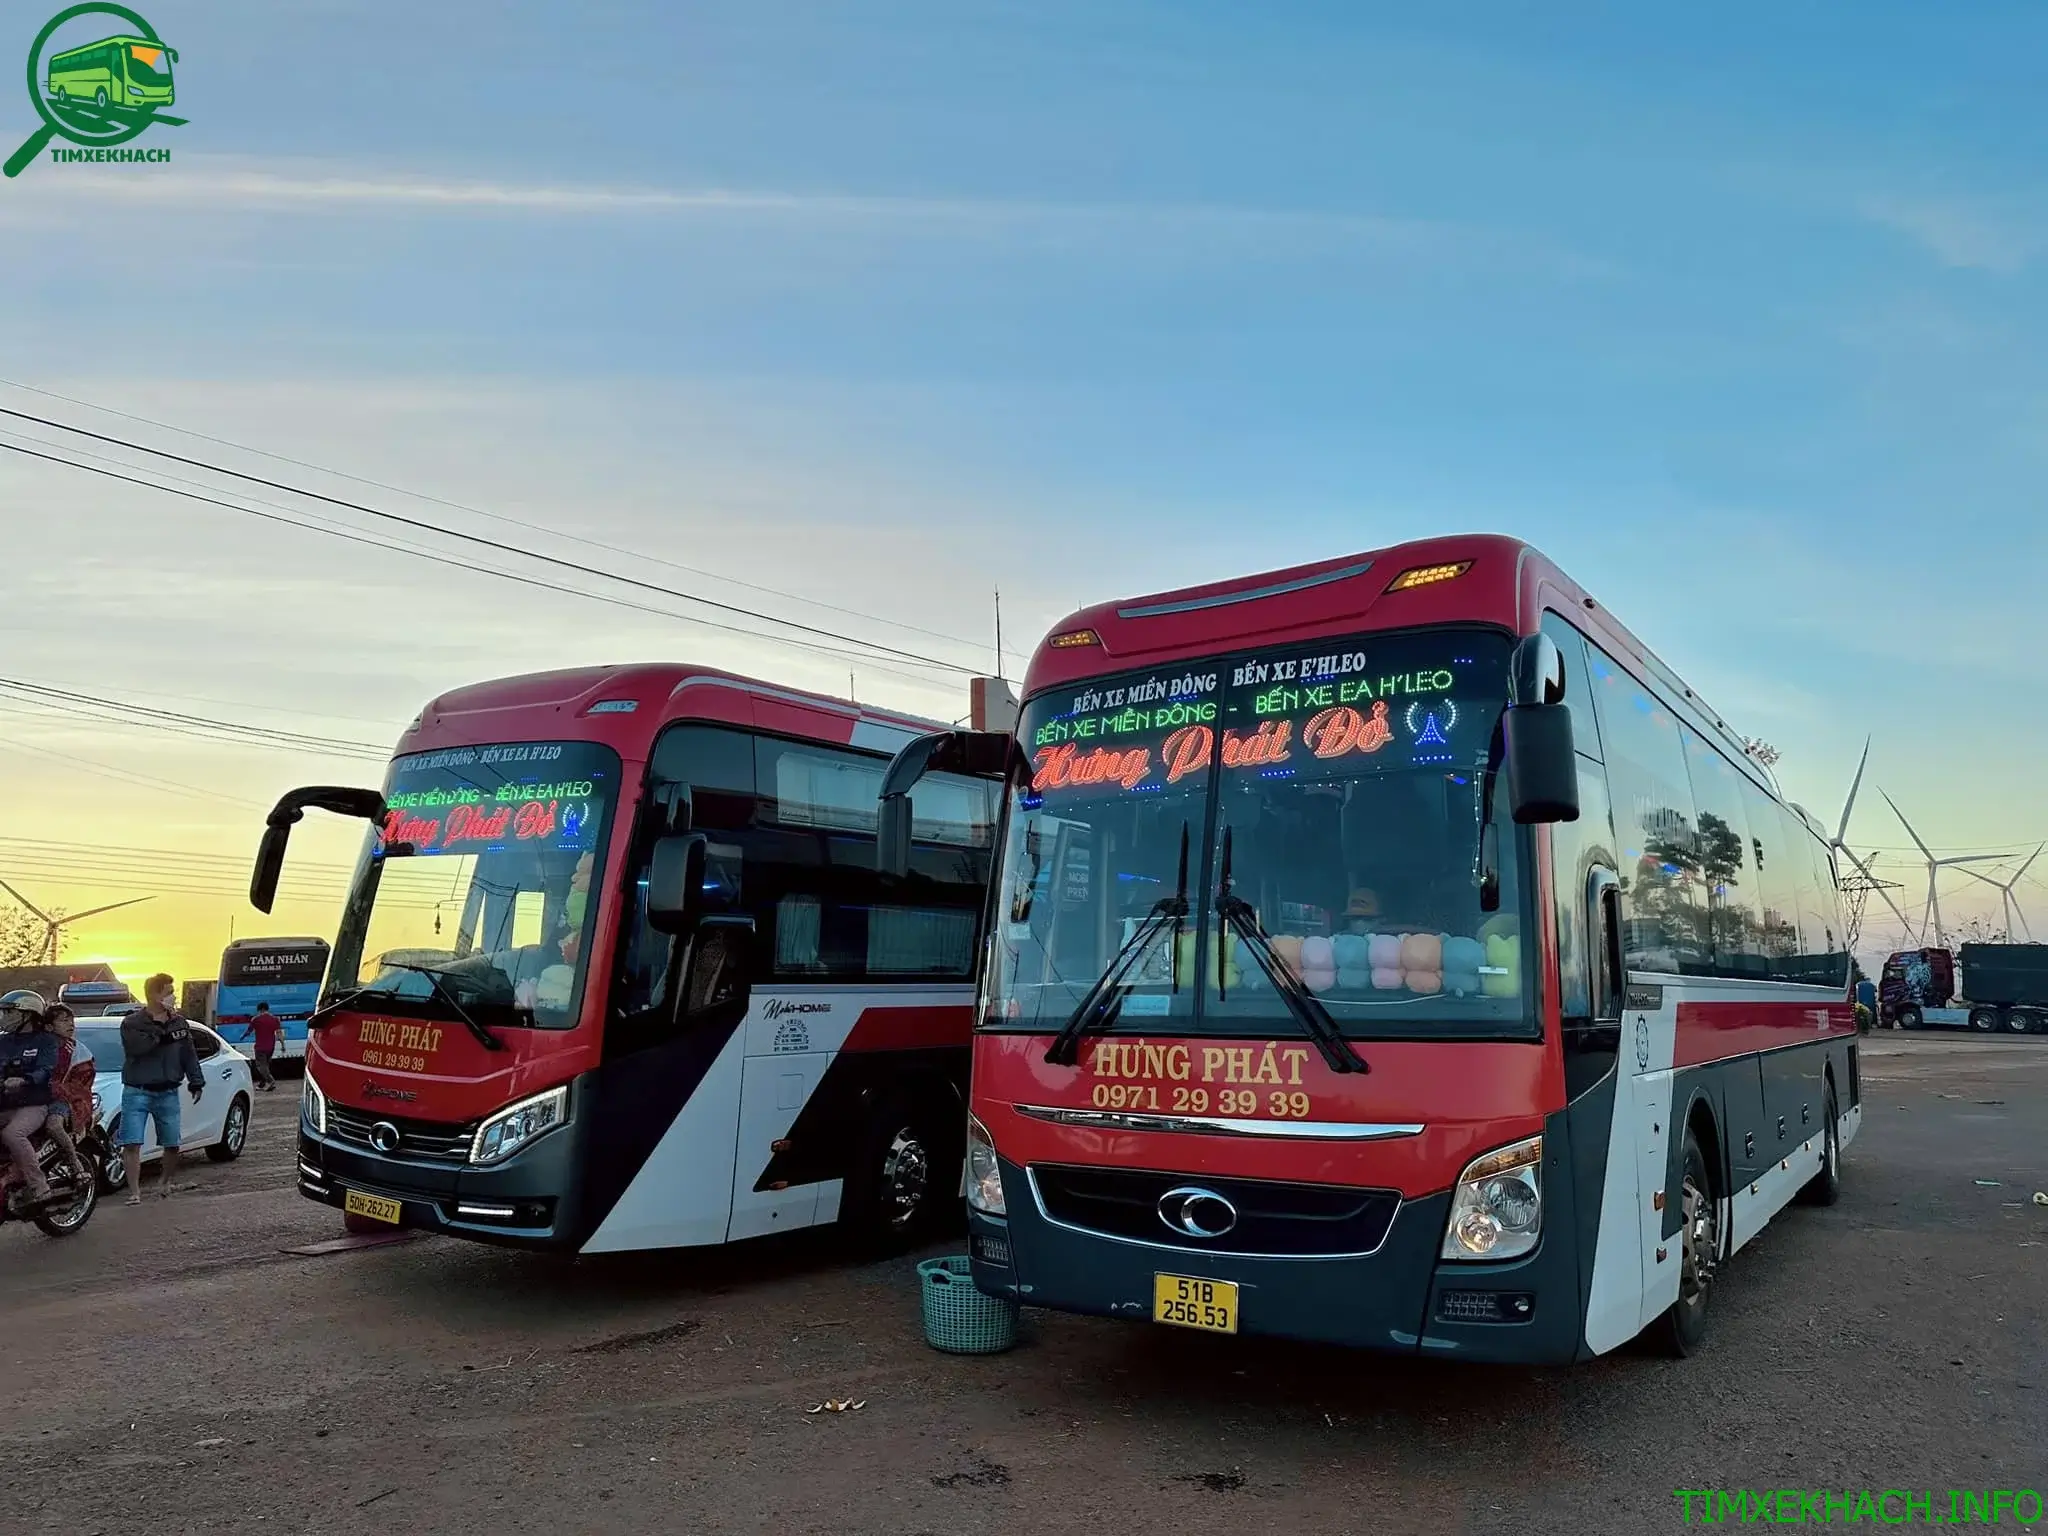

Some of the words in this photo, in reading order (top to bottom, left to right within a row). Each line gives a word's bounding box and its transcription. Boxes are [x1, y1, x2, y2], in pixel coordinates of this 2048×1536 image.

[1073, 688, 1102, 714] BẾN
[1104, 689, 1125, 708] XE
[1127, 676, 1168, 704] MIỀN
[1169, 673, 1217, 696] ĐÔNG
[1232, 660, 1269, 687] BẾN
[1271, 660, 1296, 682] XE
[1036, 719, 1068, 745] BẾN
[1072, 719, 1096, 738] XE
[1101, 707, 1150, 735] MIỀN
[1155, 702, 1217, 727] ĐÔNG
[1255, 685, 1298, 714] BẾN
[1304, 684, 1333, 707] XE
[1340, 680, 1372, 702] EA
[1380, 670, 1453, 697] H'LEO
[500, 747, 514, 762] XE
[514, 747, 528, 761] EA
[518, 783, 537, 800] XE
[536, 783, 553, 799] EA
[398, 1021, 442, 1052] PHÁT
[363, 1049, 382, 1065] 0961
[385, 1053, 397, 1067] 29
[398, 1055, 410, 1069] 39
[411, 1056, 424, 1071] 39
[1094, 1038, 1191, 1080] HƯNG
[1202, 1041, 1309, 1085] PHÁT
[1093, 1083, 1160, 1110] 0971
[1173, 1087, 1209, 1113] 29
[1219, 1089, 1257, 1115] 39
[1269, 1091, 1310, 1117] 39
[1178, 1279, 1213, 1303] 51B
[1163, 1300, 1228, 1329] 256.53
